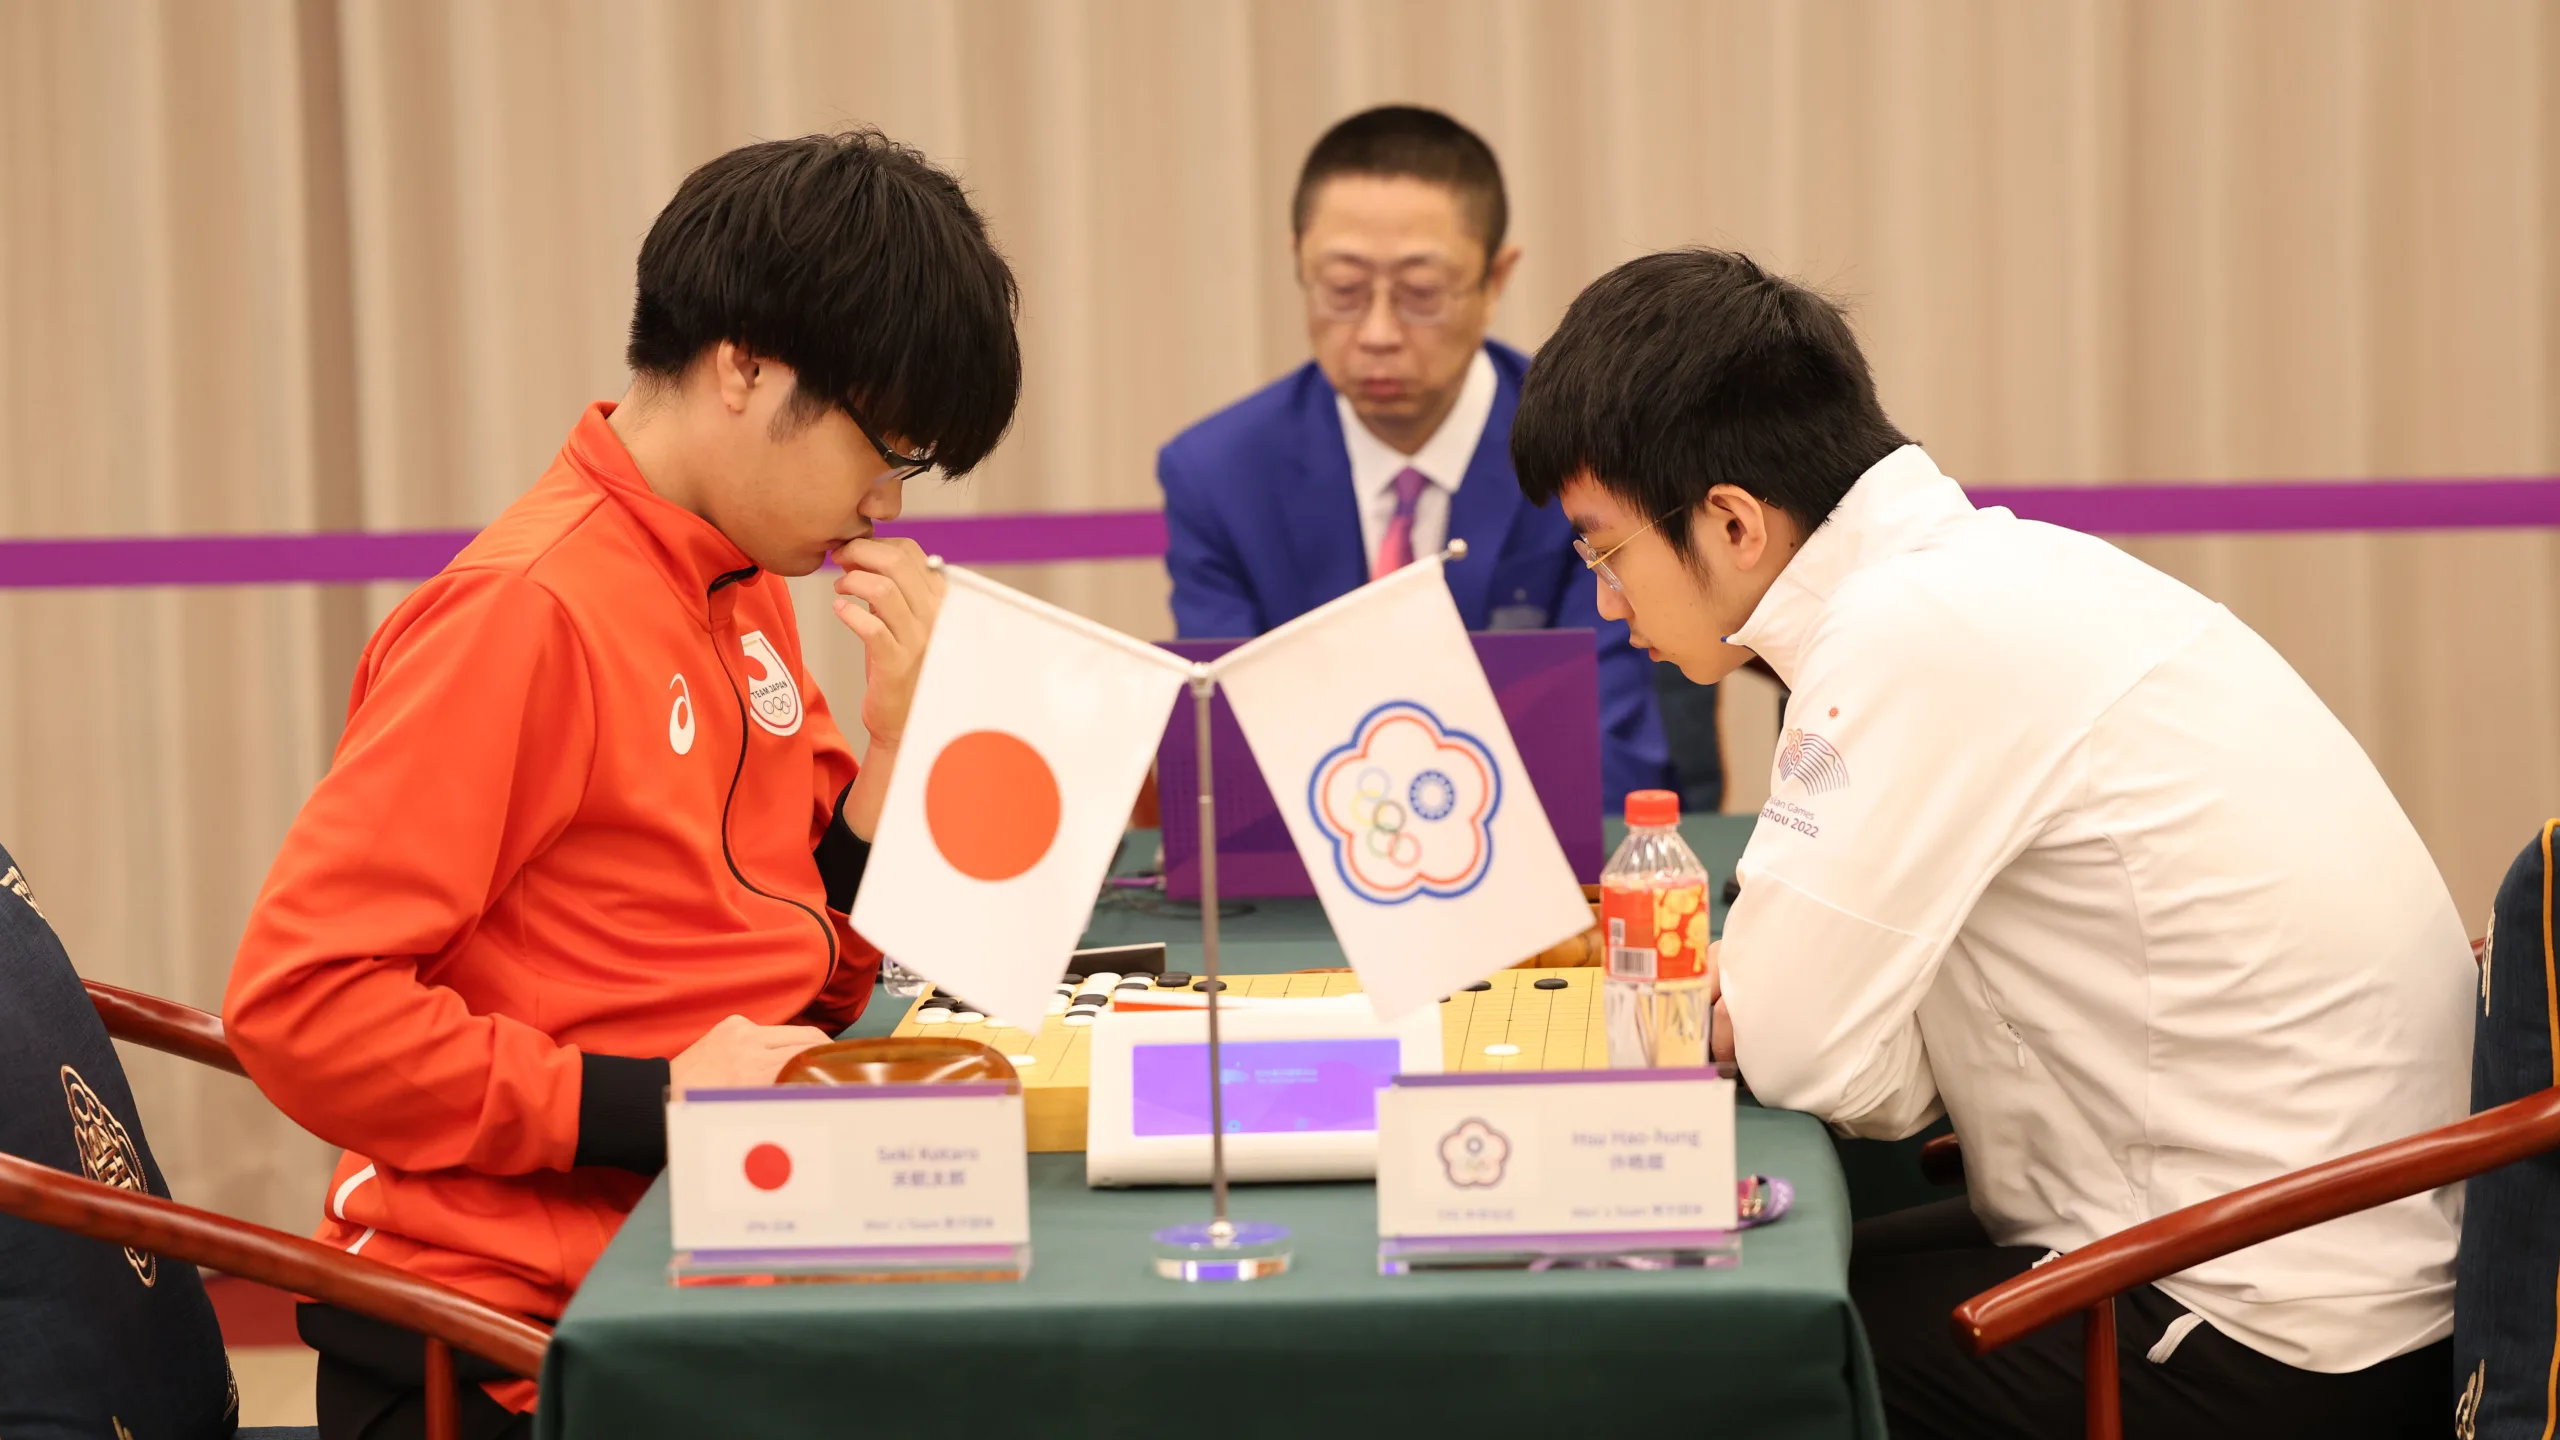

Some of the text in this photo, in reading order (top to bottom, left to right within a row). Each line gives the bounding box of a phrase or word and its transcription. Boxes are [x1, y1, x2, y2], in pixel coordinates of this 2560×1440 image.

[750, 680, 788, 699] TEAM JAPAN
[1769, 797, 1815, 820] sian Games
[1761, 807, 1819, 838] zhou 2022
